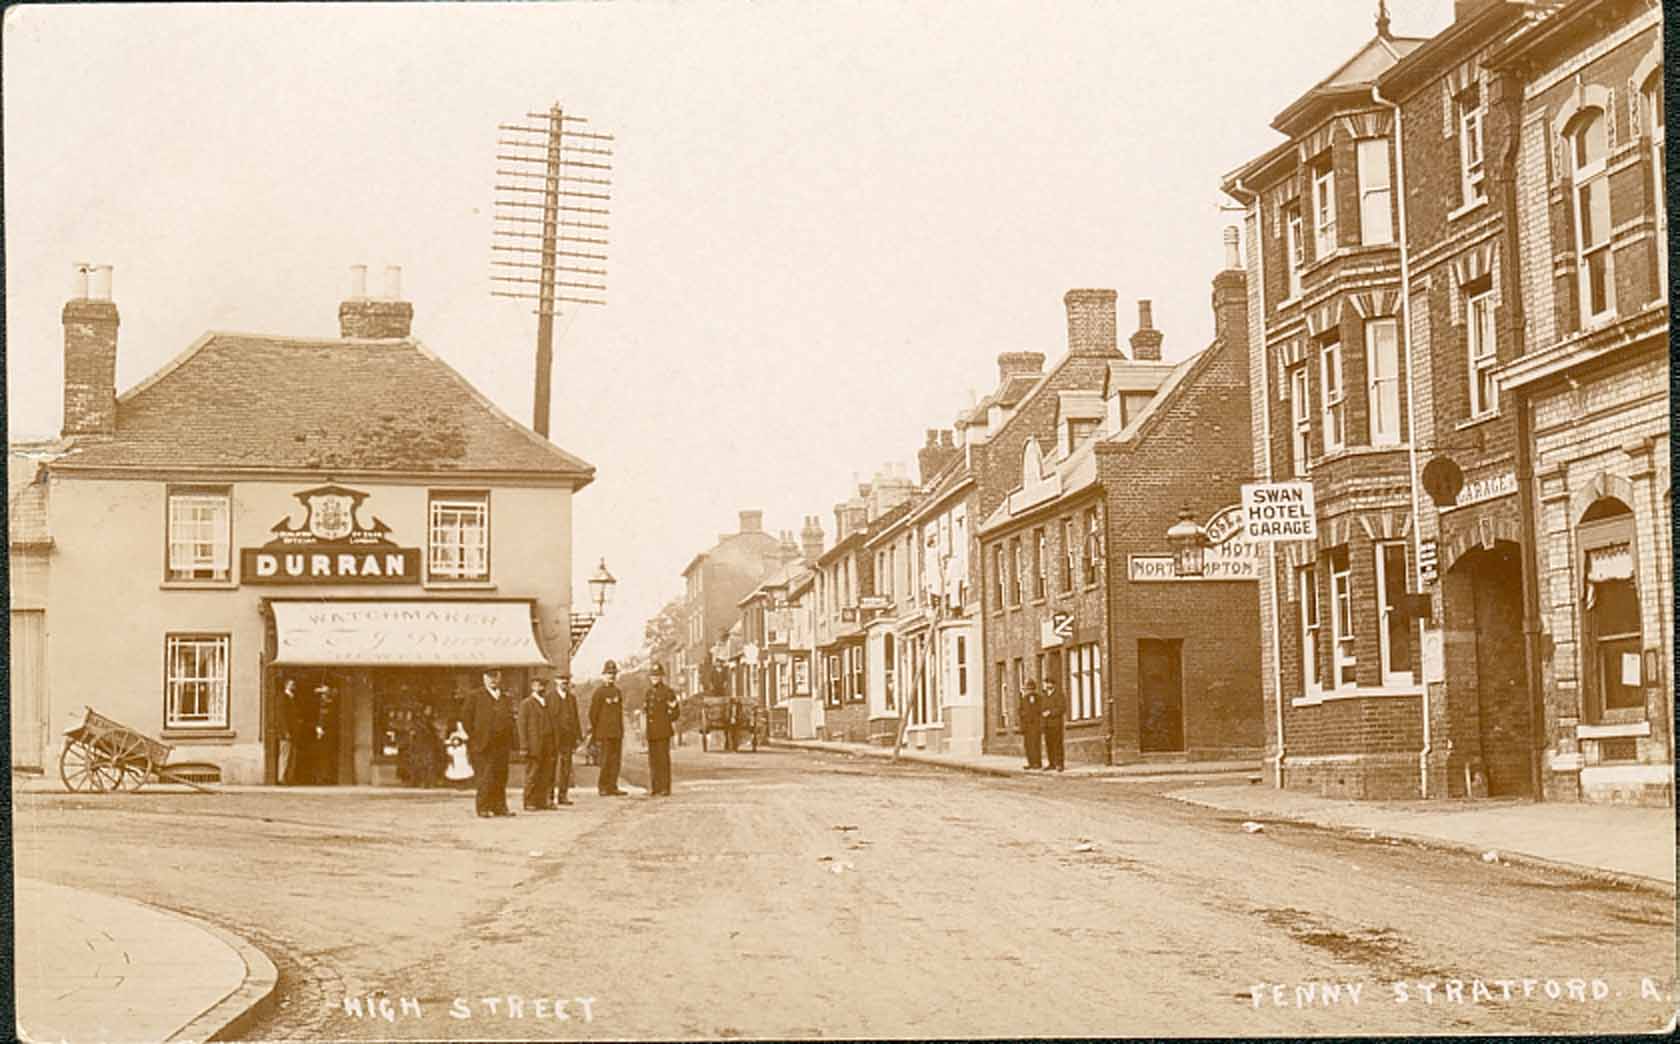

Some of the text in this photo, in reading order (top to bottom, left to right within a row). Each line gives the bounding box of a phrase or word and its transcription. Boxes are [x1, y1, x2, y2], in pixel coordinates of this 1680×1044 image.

[1253, 488, 1303, 503] SWAN
[1249, 504, 1311, 520] HOTEL
[1249, 520, 1312, 536] GARAGE
[1222, 542, 1260, 558] HOT
[256, 553, 405, 577] DURRAN
[309, 608, 498, 625] WATCHMAKER
